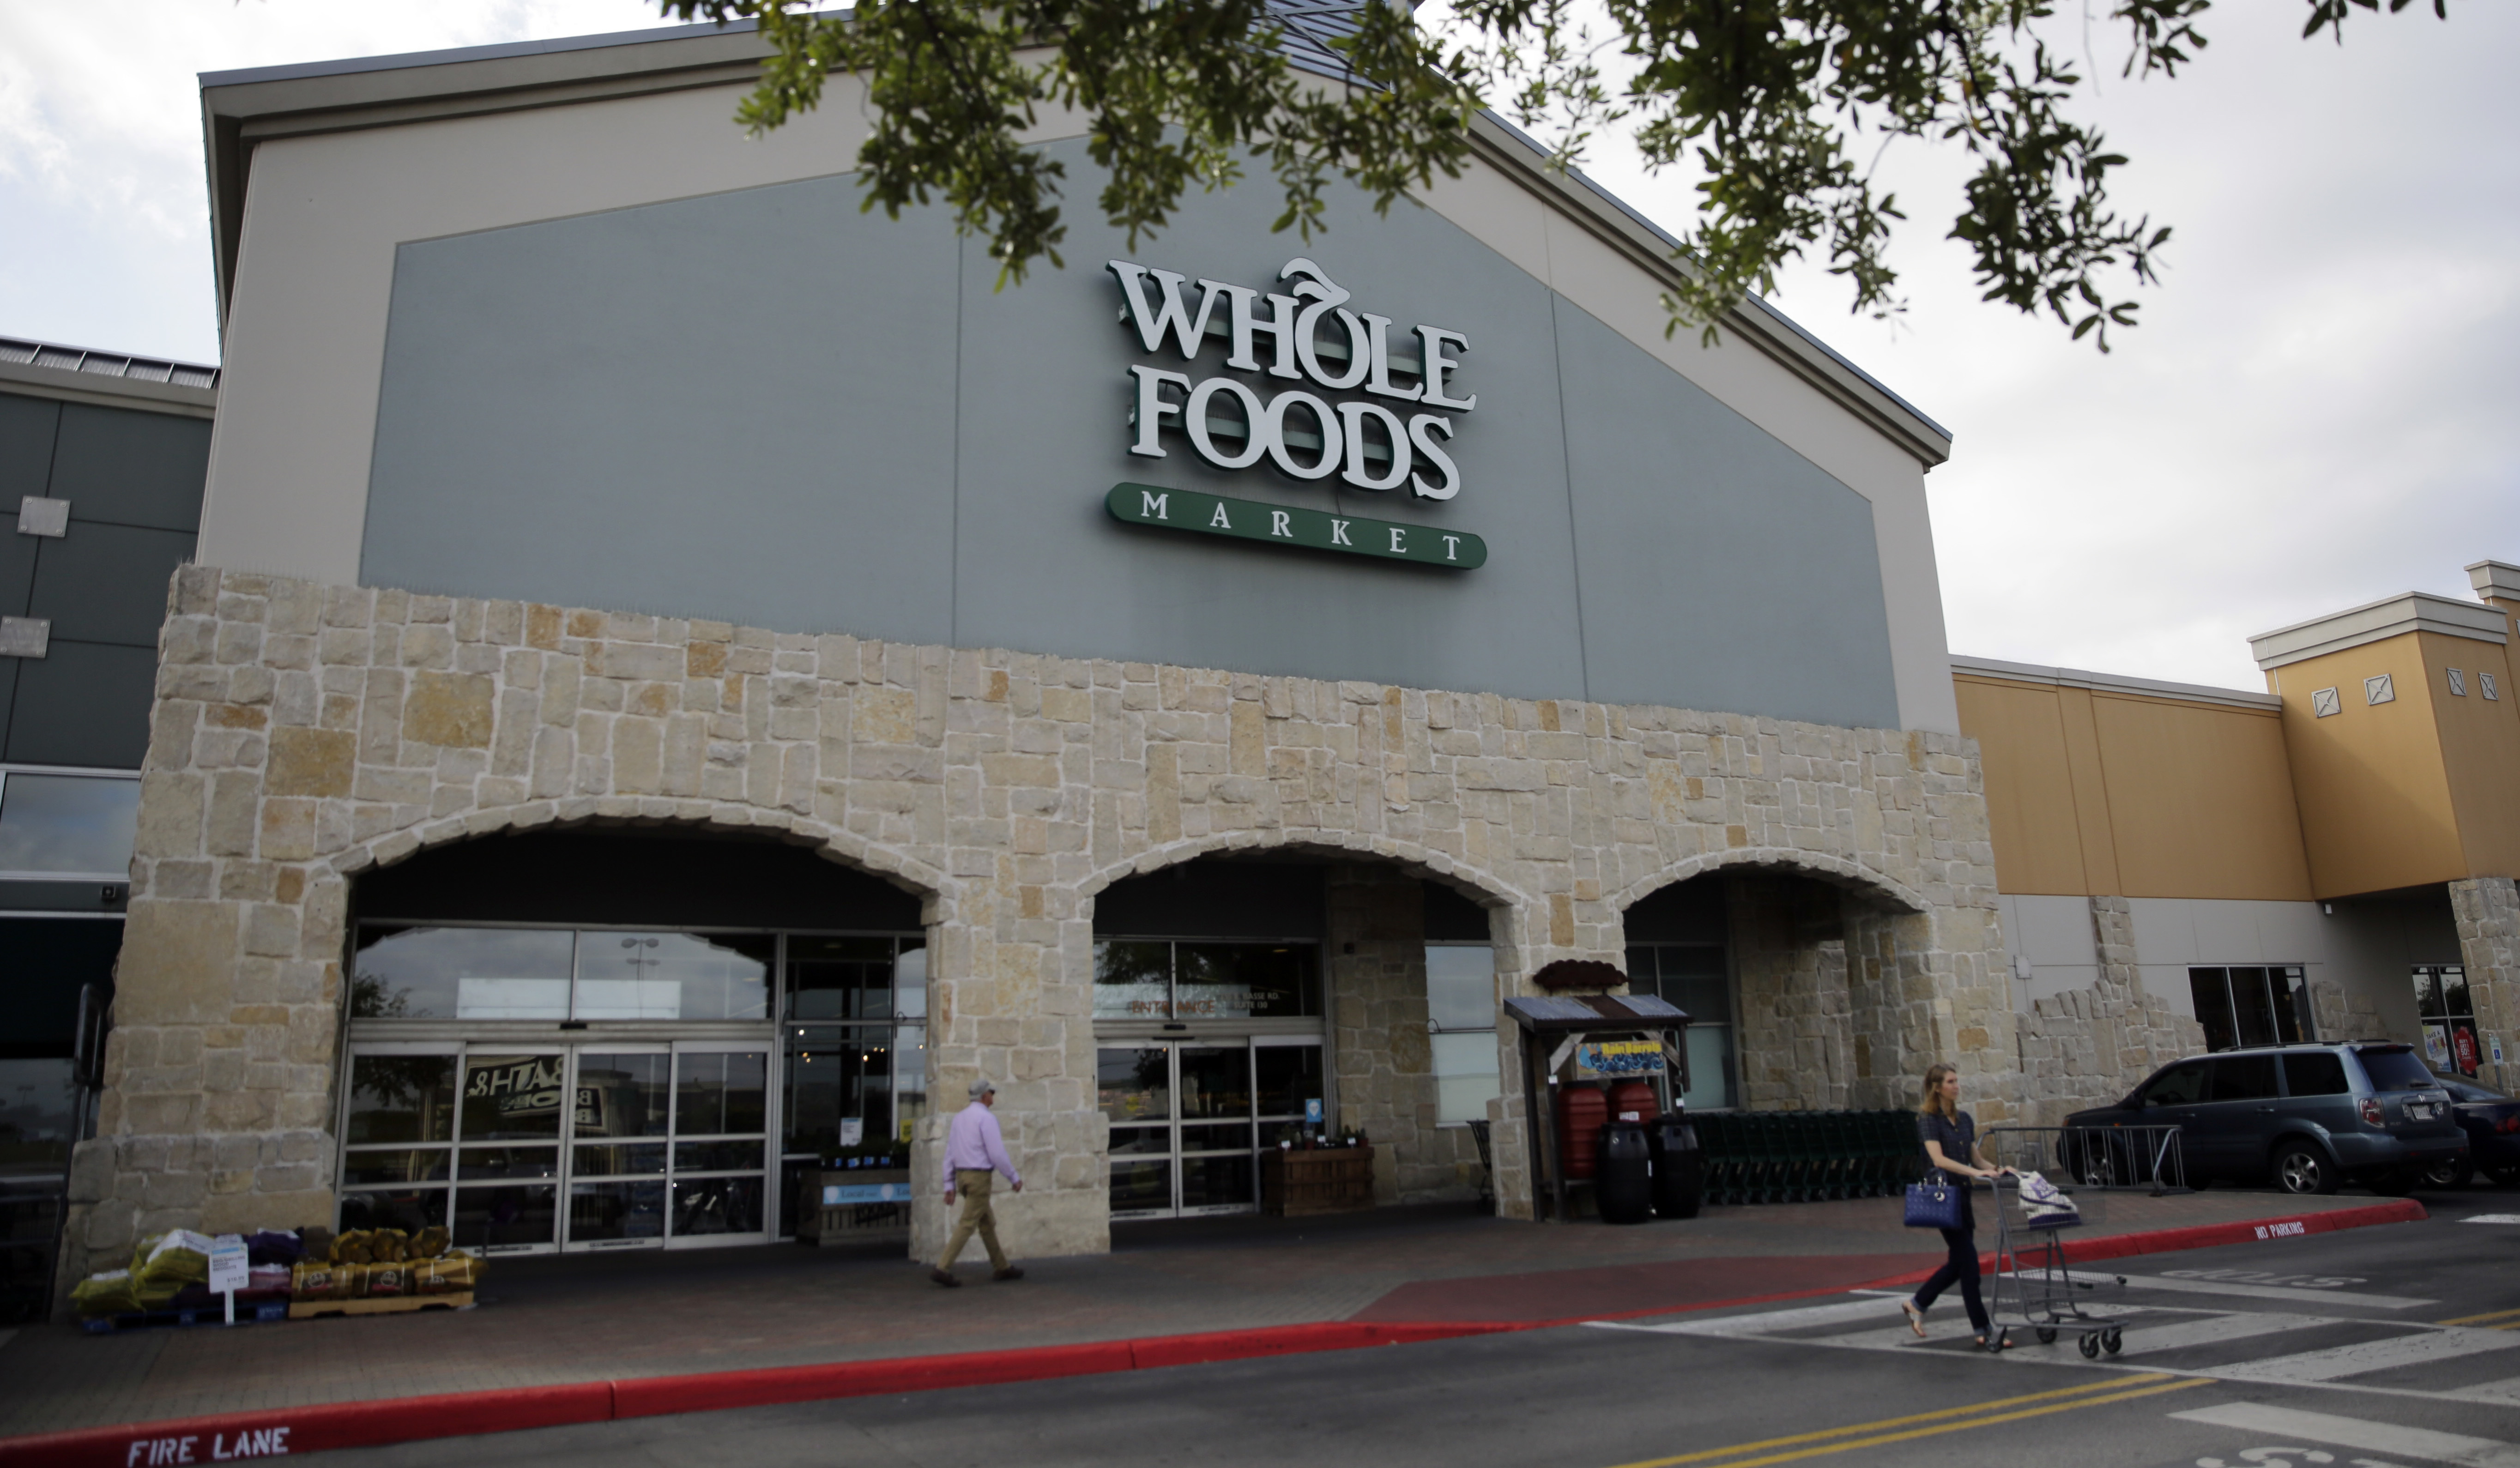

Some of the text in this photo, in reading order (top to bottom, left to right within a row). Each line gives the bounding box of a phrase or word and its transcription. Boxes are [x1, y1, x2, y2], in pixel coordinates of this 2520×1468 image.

[1106, 257, 1477, 412] WHOLE
[1128, 364, 1461, 501] FOODS
[1141, 491, 1461, 560] MARKET
[1132, 1000, 1215, 1014] ENTRANCE
[1602, 1043, 1625, 1054] Rain
[841, 1189, 864, 1198] Local
[2254, 1221, 2305, 1239] NO PARKING
[128, 1427, 290, 1468] FIRE LANE
